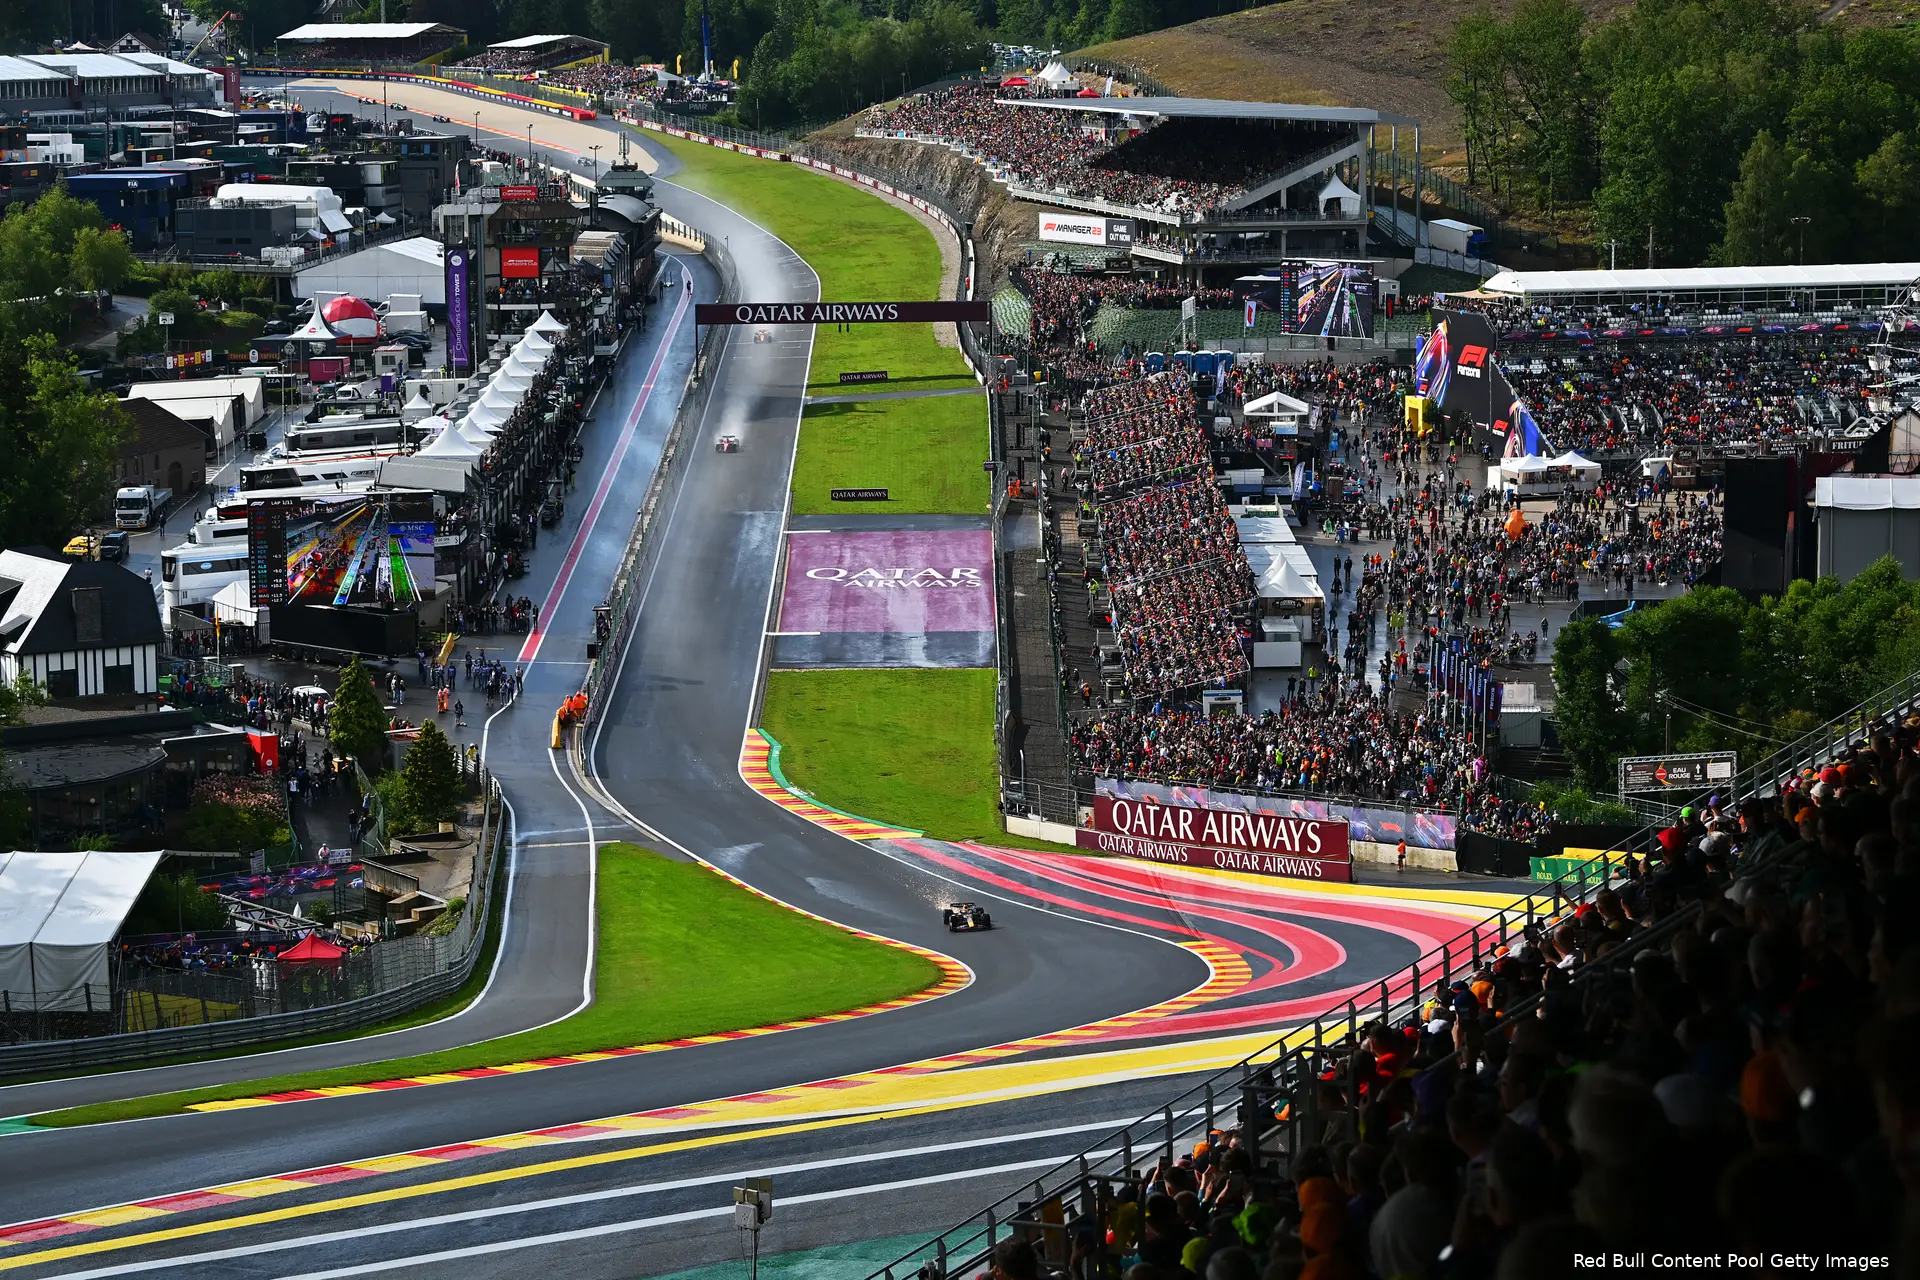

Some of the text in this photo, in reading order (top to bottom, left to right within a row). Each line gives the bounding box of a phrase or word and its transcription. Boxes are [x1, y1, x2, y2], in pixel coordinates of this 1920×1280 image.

[1056, 224, 1091, 235] MANAGER
[1092, 226, 1102, 235] 23
[1112, 224, 1127, 233] GAME
[1109, 233, 1131, 242] OUT NOW
[735, 304, 899, 323] QATAR AIRWAYS
[832, 490, 887, 499] QATAR AIRWAYS
[806, 567, 981, 588] QATAR AIRWAYS
[1112, 800, 1321, 854] QATAR AIRWAYS
[1098, 833, 1188, 862] QATAR AIRWAYS
[1214, 850, 1322, 877] QATAR AIRWAYS
[1536, 872, 1553, 880] ROLEX
